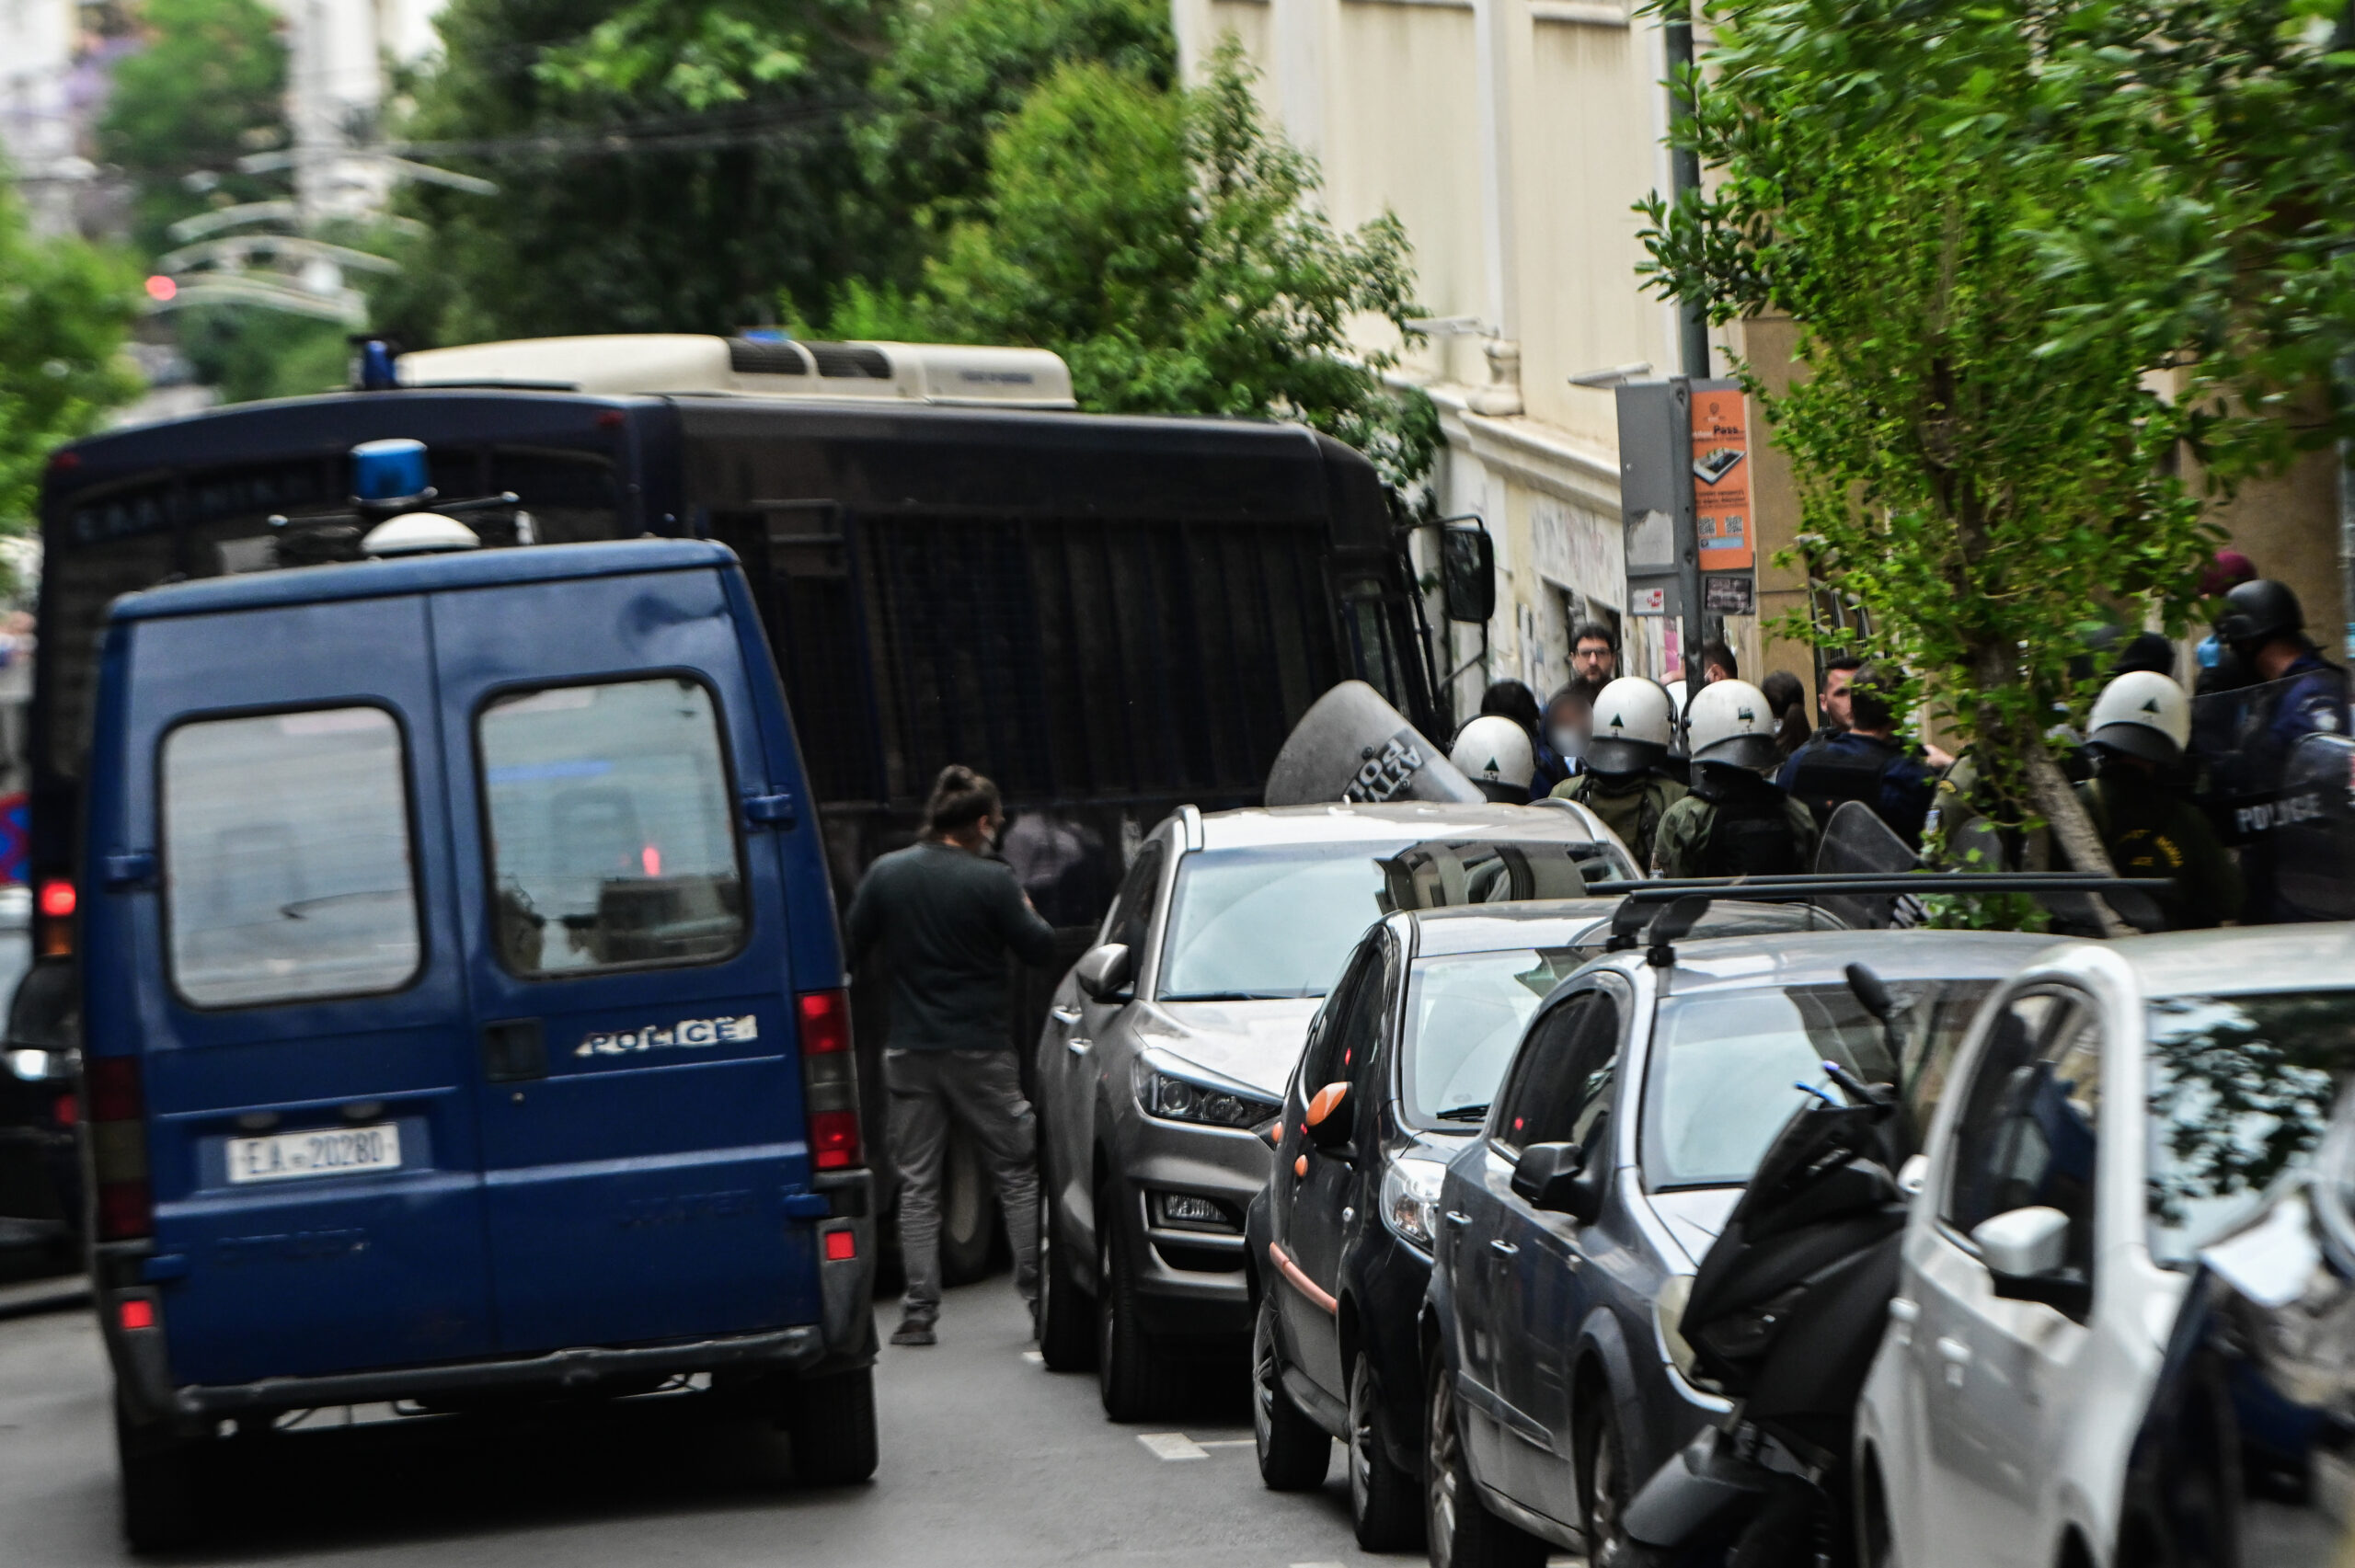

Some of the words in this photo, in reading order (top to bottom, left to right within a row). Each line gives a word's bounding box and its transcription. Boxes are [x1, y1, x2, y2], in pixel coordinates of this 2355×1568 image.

[1344, 738, 1405, 803] POL
[1363, 744, 1423, 803] ΑΣΤΥ
[585, 1015, 741, 1055] POLICE
